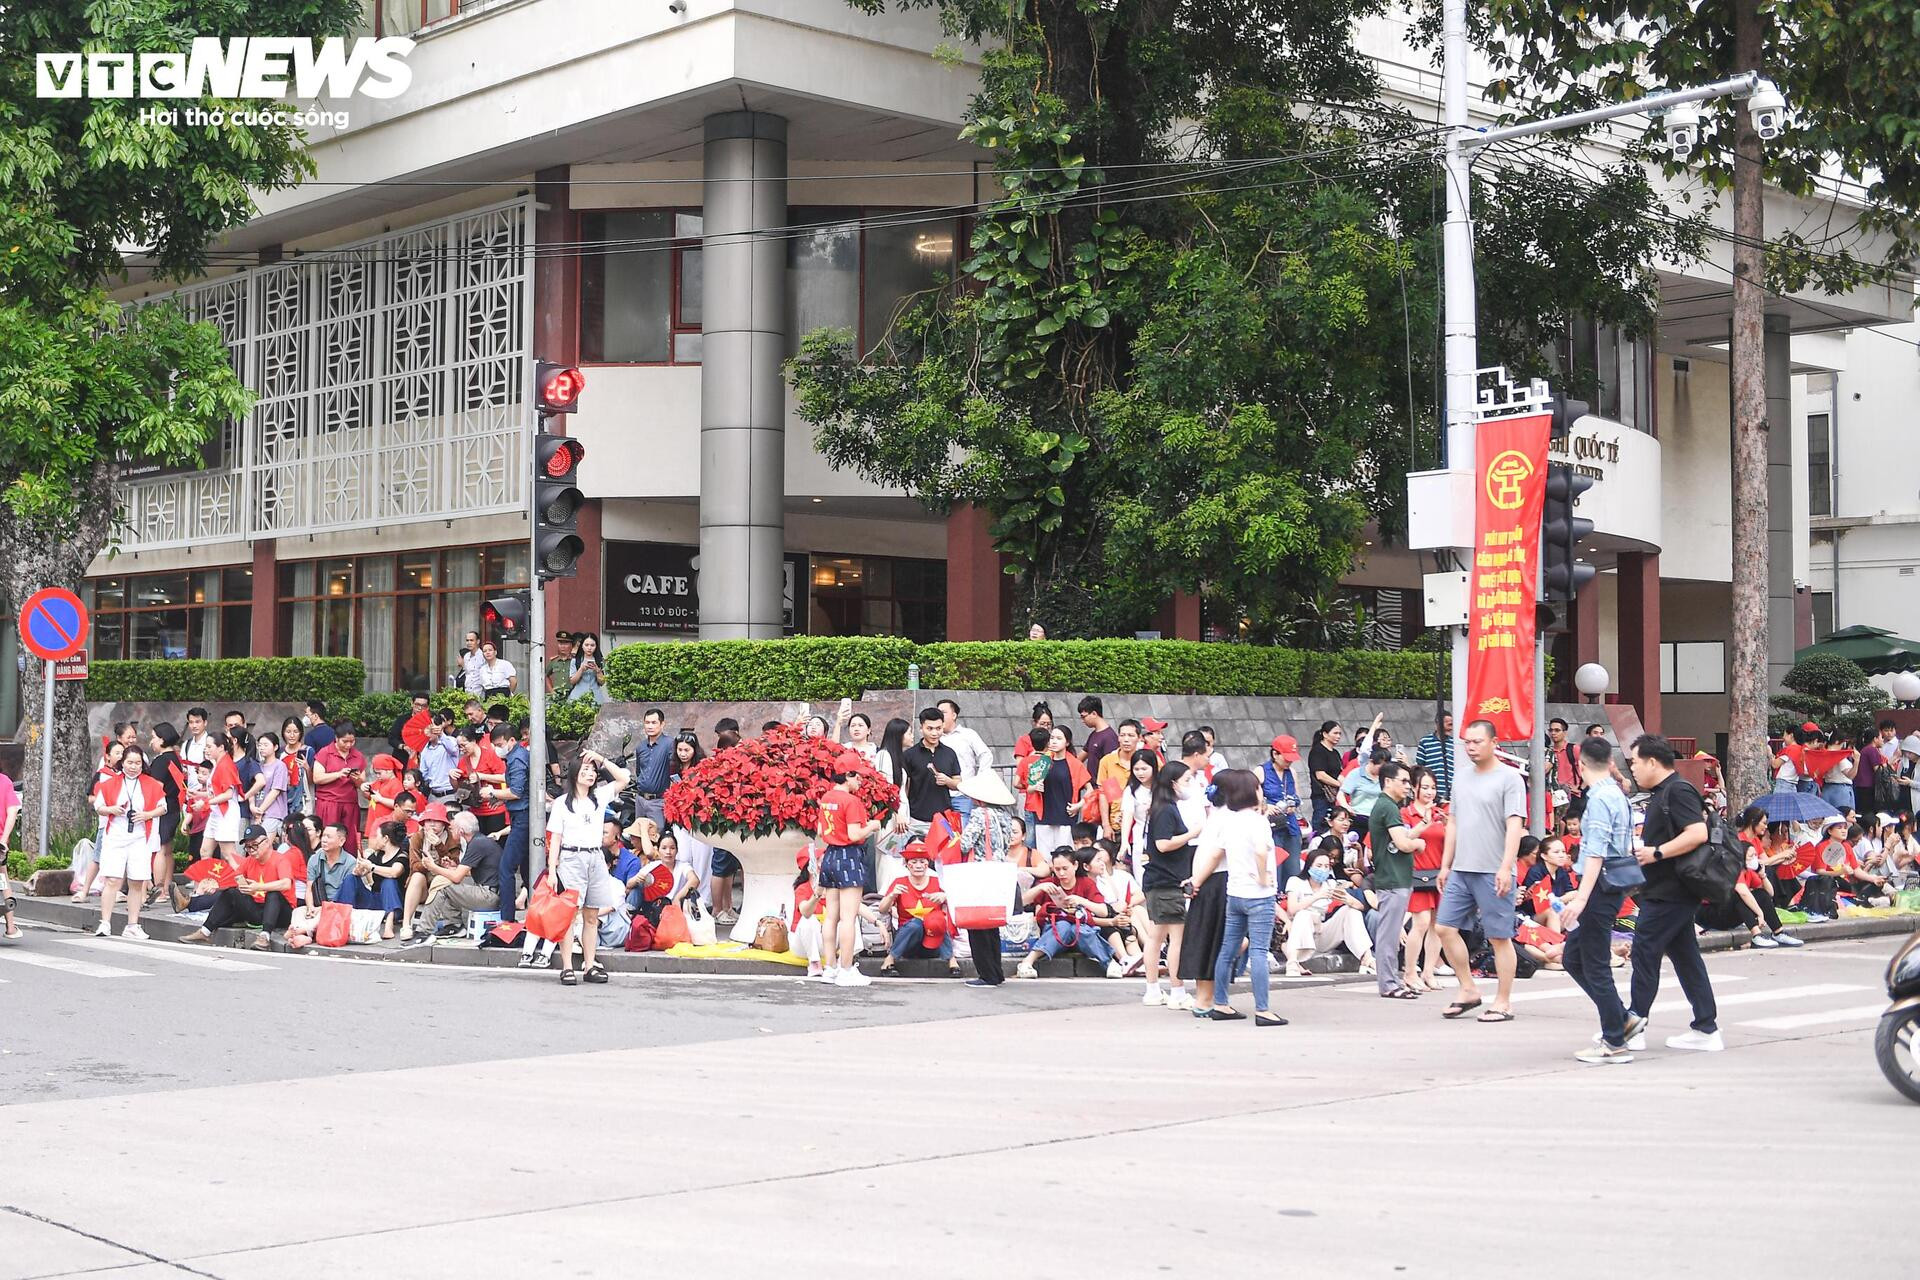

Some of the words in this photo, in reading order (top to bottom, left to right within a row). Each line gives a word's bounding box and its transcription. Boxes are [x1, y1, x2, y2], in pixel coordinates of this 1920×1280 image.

[1575, 432, 1605, 460] QUỐC
[1606, 437, 1620, 463] TẾ
[625, 574, 688, 595] CAFE
[639, 607, 651, 615] 13
